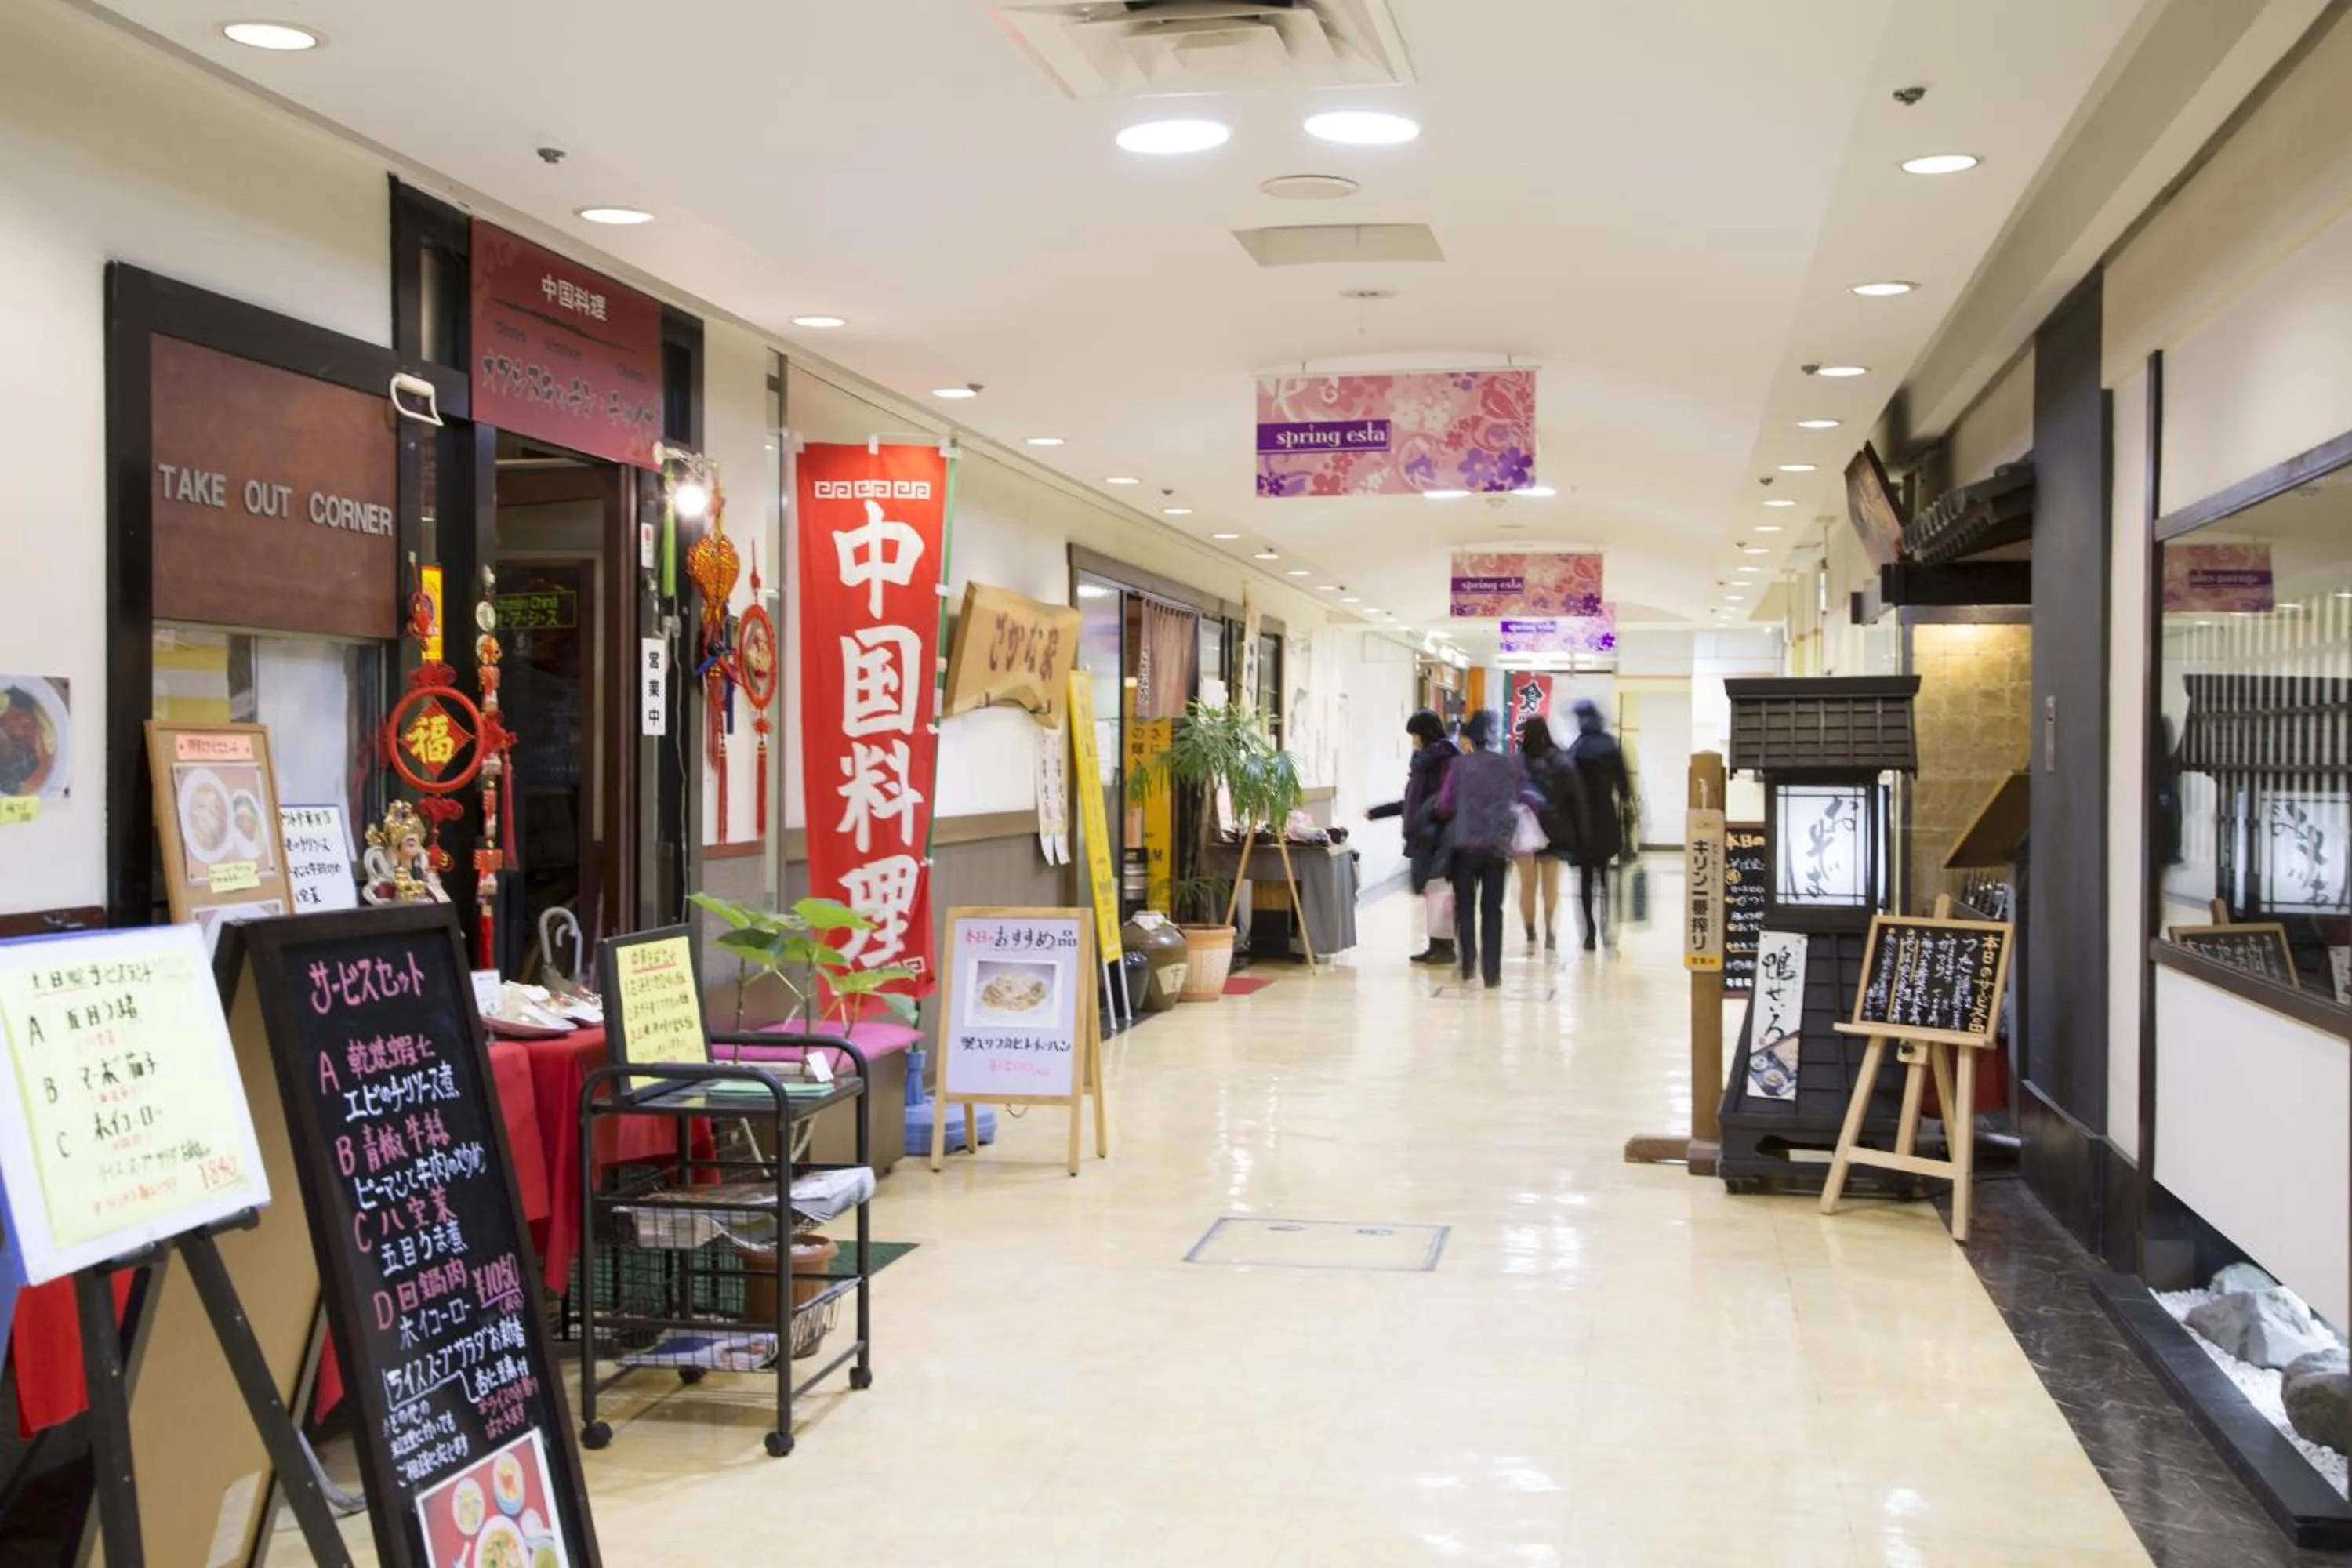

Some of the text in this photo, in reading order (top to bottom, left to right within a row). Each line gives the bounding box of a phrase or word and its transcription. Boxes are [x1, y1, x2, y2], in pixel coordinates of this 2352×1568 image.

[541, 273, 608, 321] 中国料理
[1276, 421, 1385, 448] spring esta
[158, 465, 394, 539] TAKE OUT CORNER
[1461, 579, 1497, 591] spring
[648, 651, 659, 725] 営業中
[405, 714, 456, 764] 福
[833, 499, 925, 971] 中国料理
[1692, 840, 1709, 950] キリン一番搾り
[309, 951, 425, 1014] サービスセット
[29, 1016, 45, 1046] A
[45, 1076, 58, 1104] B
[319, 1051, 340, 1095] A
[57, 1131, 71, 1158] C
[336, 1135, 356, 1176] B
[354, 1210, 372, 1253] C
[373, 1290, 395, 1330] D
[396, 1258, 468, 1312] 回鍋肉
